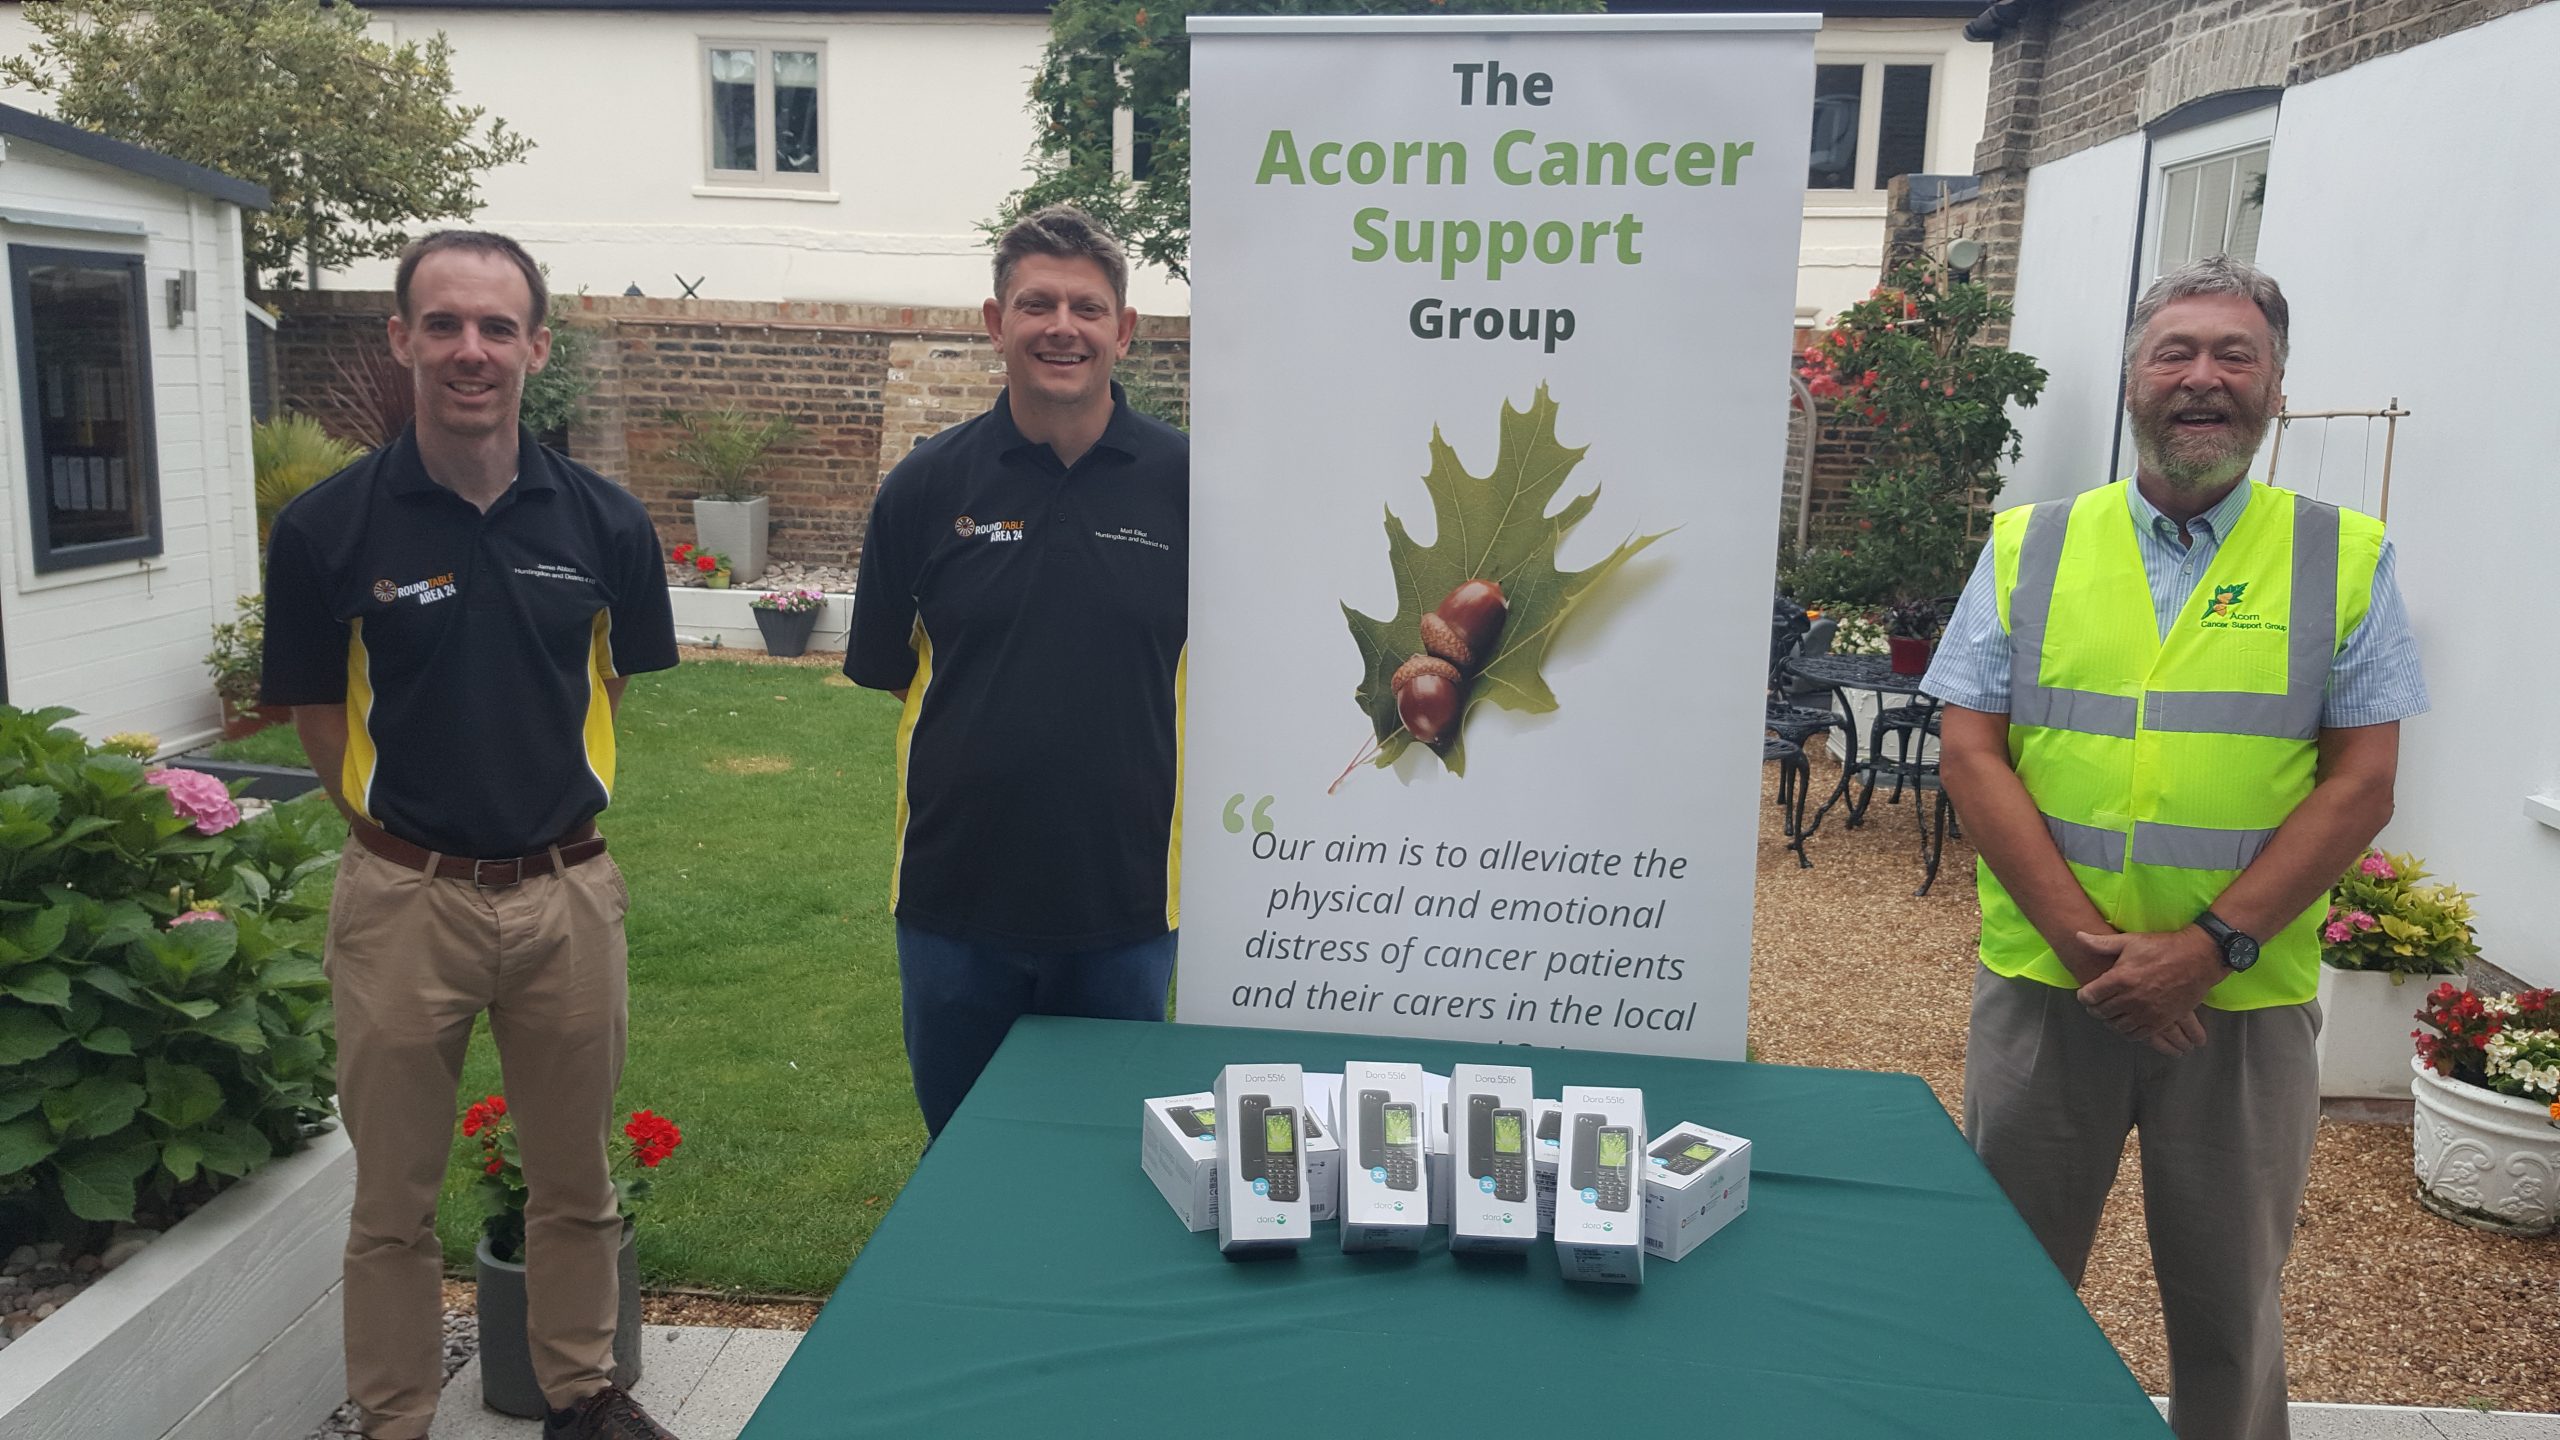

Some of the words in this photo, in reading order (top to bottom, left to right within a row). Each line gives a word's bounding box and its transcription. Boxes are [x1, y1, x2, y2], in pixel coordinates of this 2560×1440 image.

[1452, 61, 1554, 106] The
[1255, 129, 1468, 186] Acorn
[1493, 129, 1754, 187] Cancer
[1351, 207, 1644, 281] Support
[1409, 297, 1576, 354] Group
[990, 530, 1012, 542] AREA
[1012, 529, 1023, 541] 24
[1095, 531, 1127, 541] Huntingdon
[1140, 537, 1159, 548] District
[514, 567, 551, 578] Huntingdon
[419, 587, 446, 605] AREA
[444, 583, 457, 597] 24
[2230, 612, 2260, 620] Acorn
[2200, 620, 2228, 629] Cancer
[2231, 621, 2262, 629] Support
[2265, 622, 2288, 632] Group
[1252, 832, 1316, 861] Our
[1325, 835, 1387, 864] aim
[1399, 837, 1424, 867] is
[1435, 842, 1468, 869] to
[1480, 841, 1622, 877] alleviate
[1633, 847, 1688, 880] the
[1266, 881, 1406, 919] physical
[1414, 889, 1481, 919] and
[1490, 896, 1667, 930] emotional
[1245, 930, 1370, 964] distress
[1380, 936, 1419, 974] of
[1424, 945, 1538, 972] cancer
[1544, 948, 1686, 982] patients
[1231, 979, 1297, 1009] and
[1306, 981, 1385, 1014] their
[1393, 991, 1497, 1020] carers
[1506, 992, 1537, 1022] in
[1549, 994, 1603, 1027] the
[1613, 999, 1698, 1032] local
[1245, 1074, 1267, 1083] Doro
[1267, 1073, 1286, 1083] 5516
[1365, 1070, 1387, 1080] Doro
[1387, 1071, 1407, 1080] 5516
[1475, 1074, 1496, 1084] Doro
[1497, 1075, 1517, 1085] 5516
[1582, 1094, 1604, 1104] Doro
[1605, 1095, 1625, 1105] 5516
[1372, 1170, 1385, 1180] 3G
[1255, 1182, 1267, 1191] 3G
[1480, 1180, 1494, 1189] 3G
[1582, 1191, 1595, 1200] 3G
[1374, 1200, 1393, 1210] doro
[1256, 1214, 1276, 1224] doro
[1482, 1212, 1501, 1222] doro
[1582, 1221, 1602, 1231] doro
